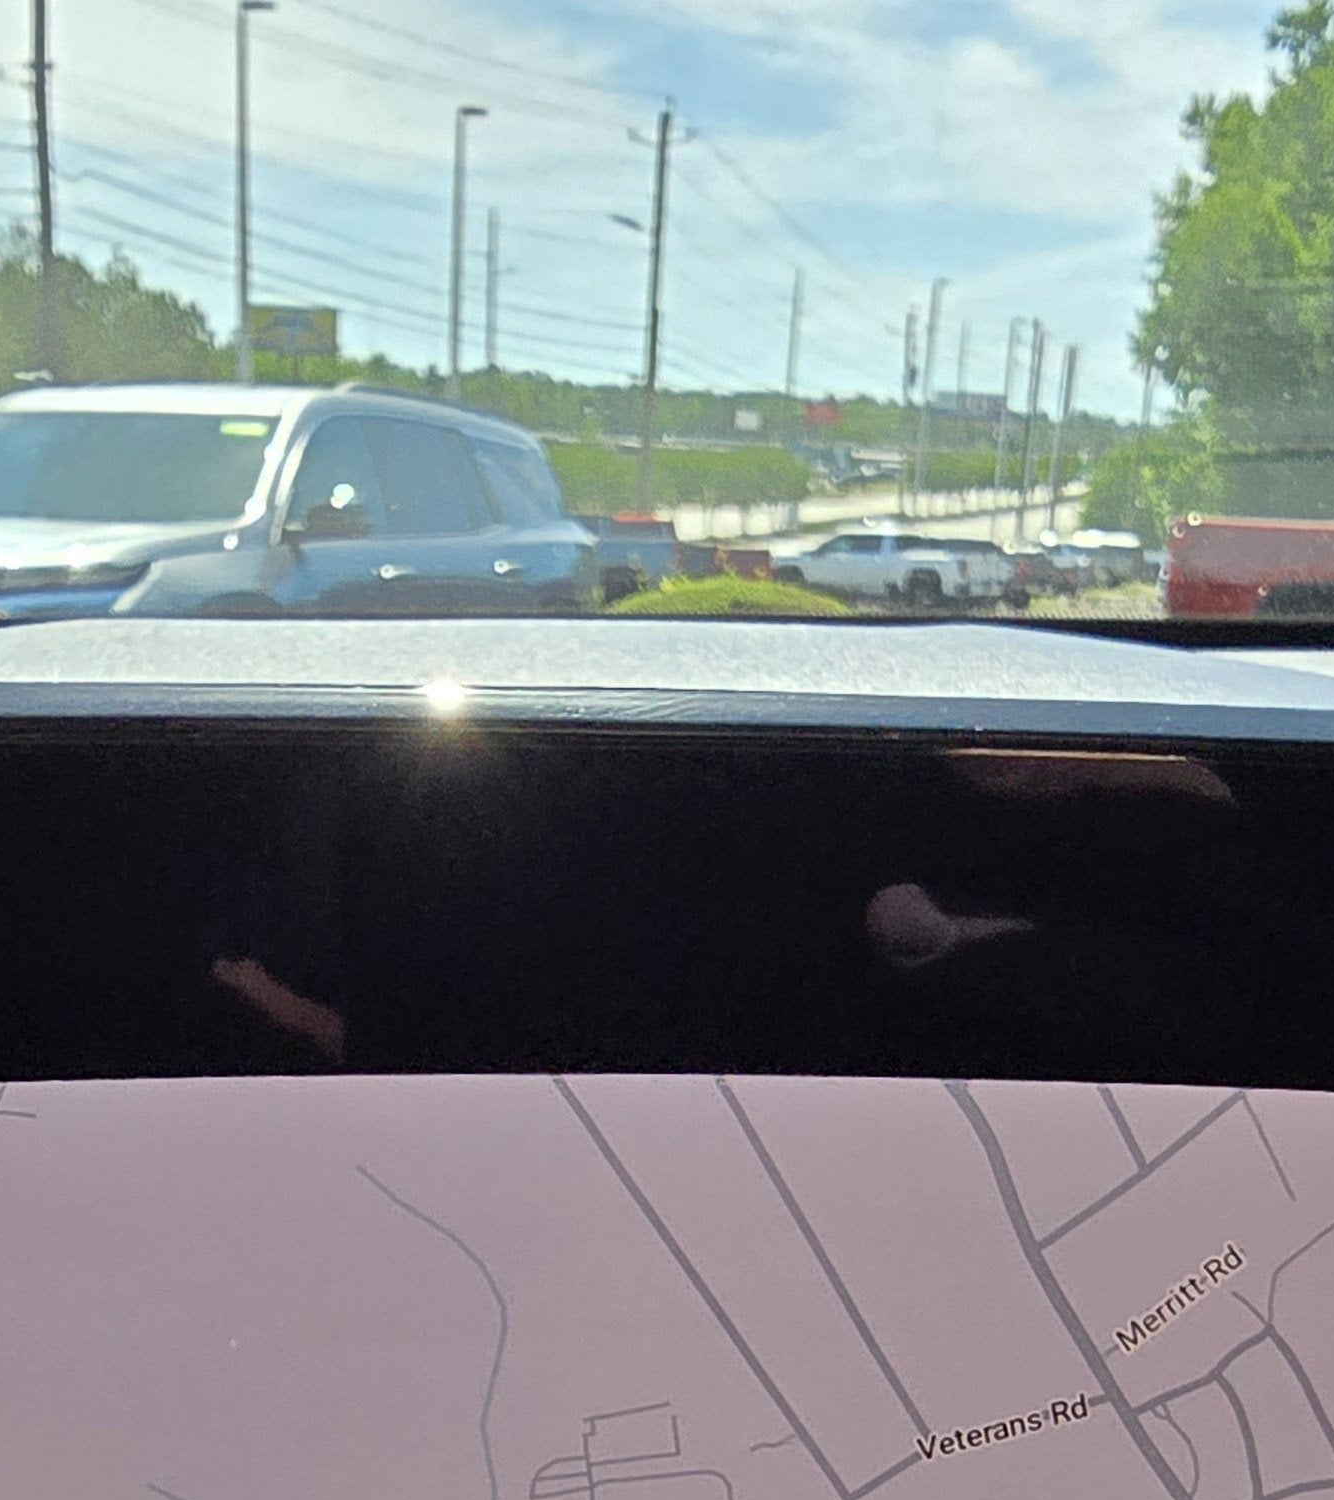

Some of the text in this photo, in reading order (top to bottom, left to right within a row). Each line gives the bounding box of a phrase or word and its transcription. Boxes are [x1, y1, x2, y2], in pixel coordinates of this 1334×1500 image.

[1116, 1244, 1244, 1352] Merritt Rd
[917, 1394, 1088, 1460] Veterans Rd
